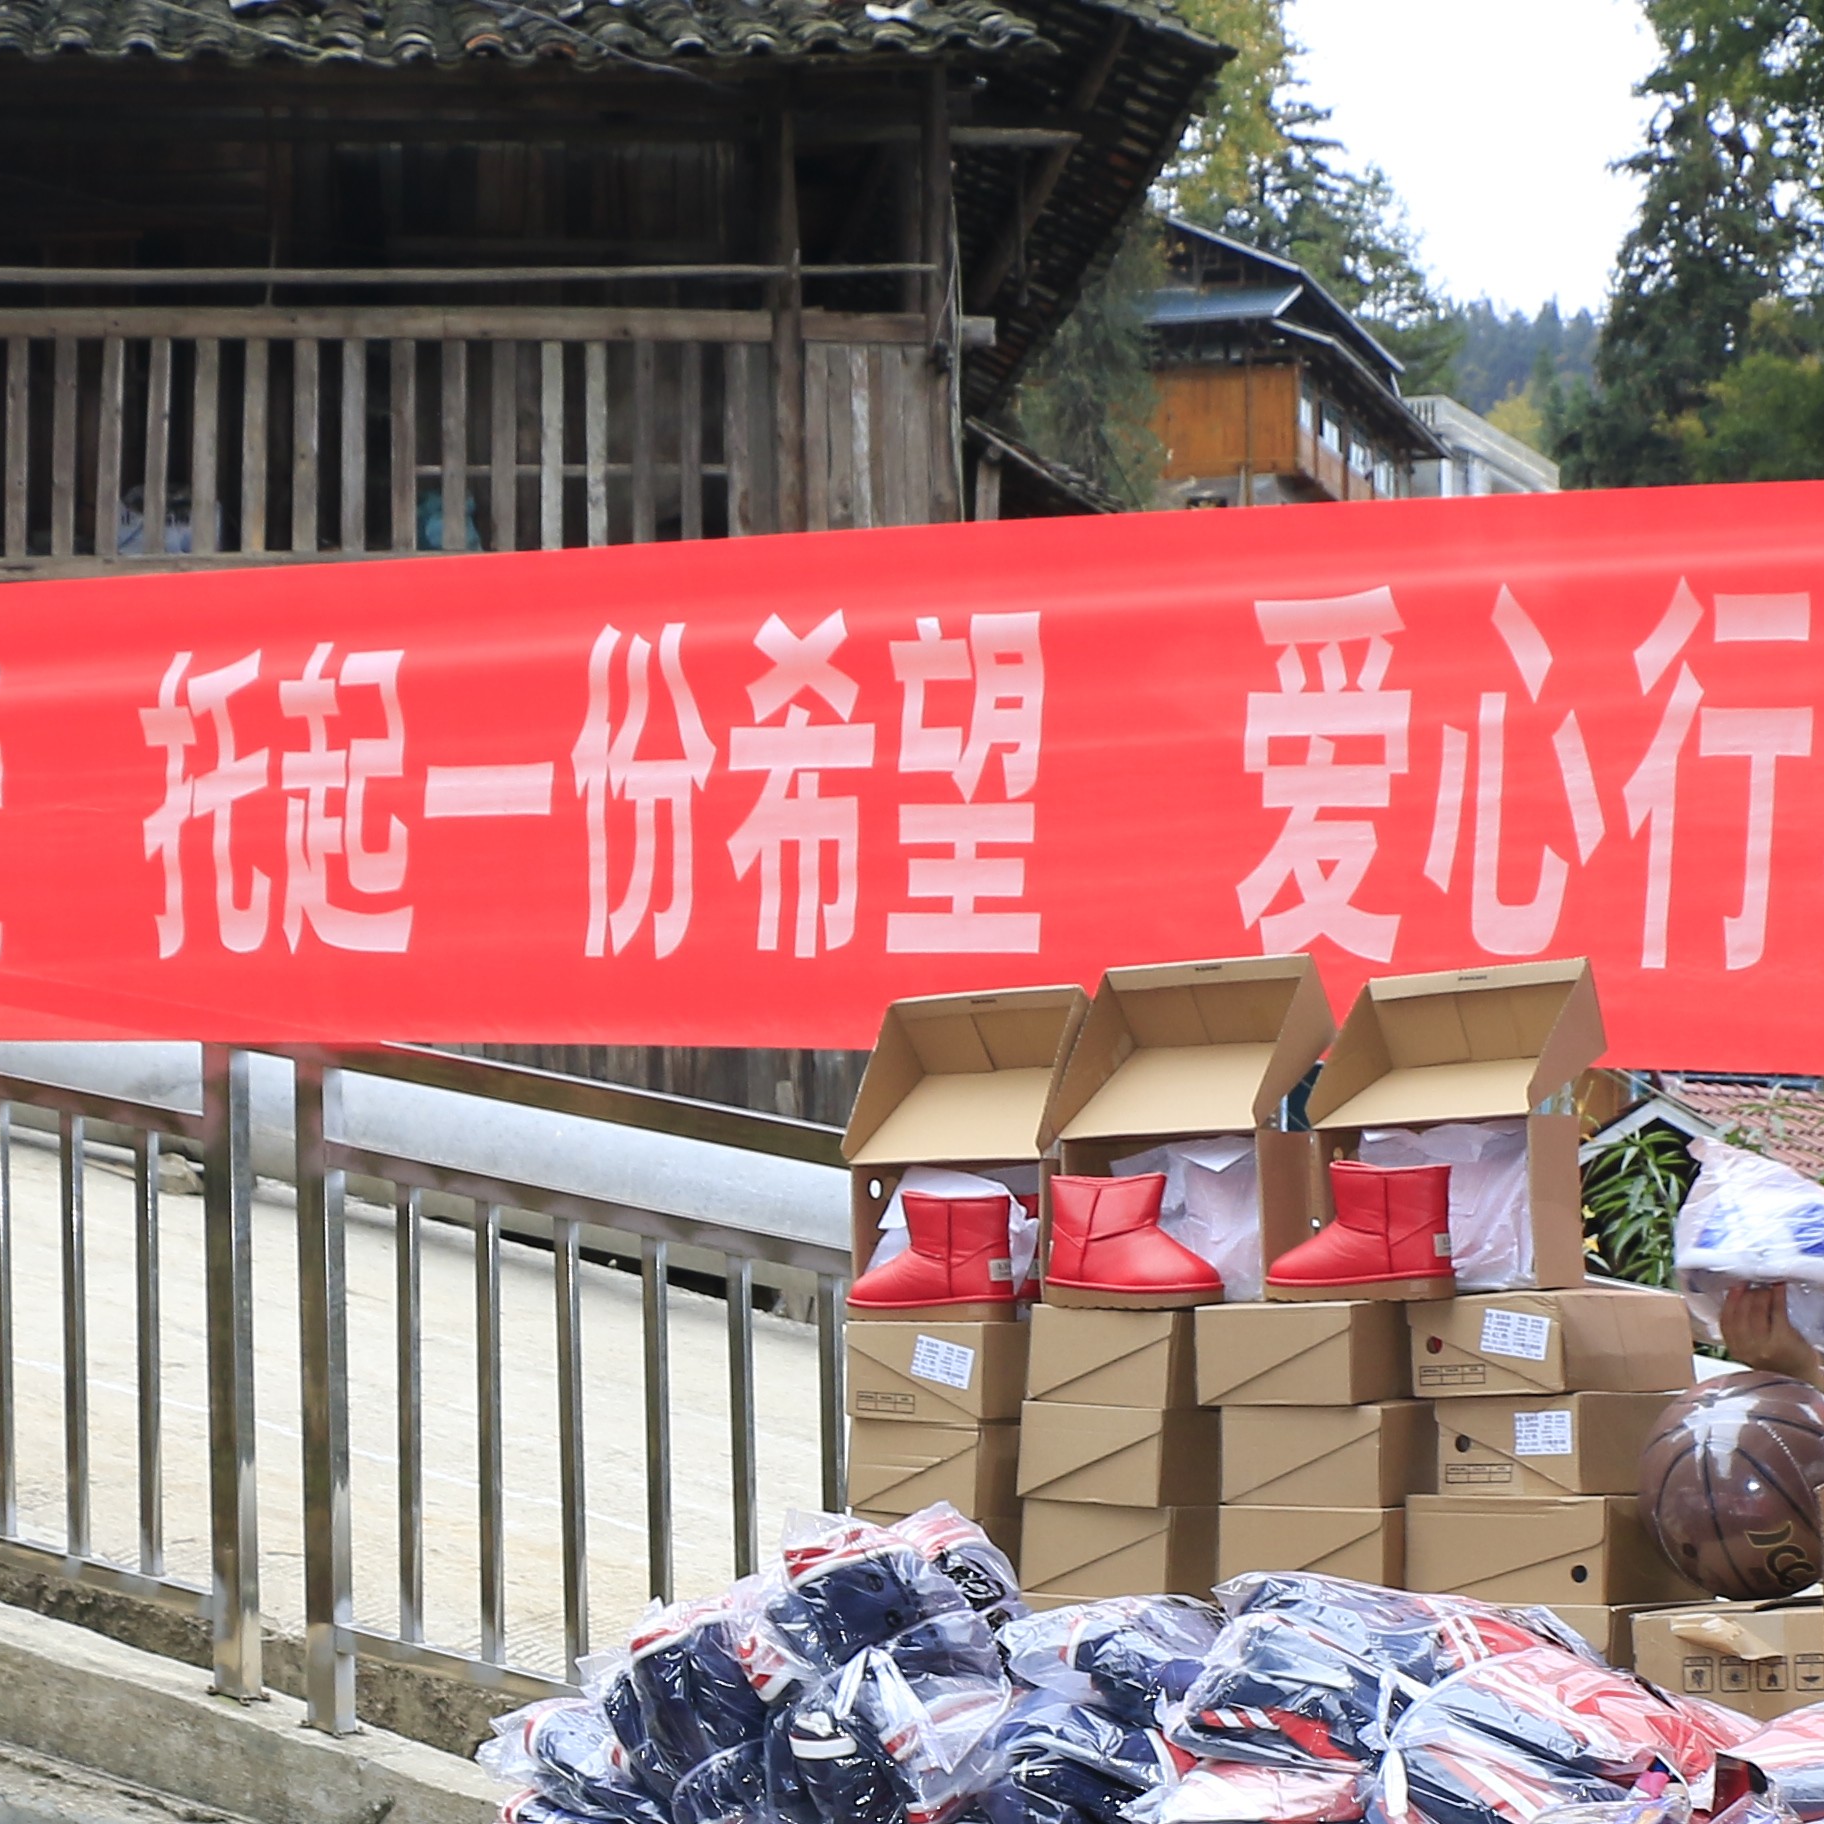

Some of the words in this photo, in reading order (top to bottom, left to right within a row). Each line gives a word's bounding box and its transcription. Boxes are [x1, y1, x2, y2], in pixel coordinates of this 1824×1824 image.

[143, 608, 1045, 964] 托起一份希望
